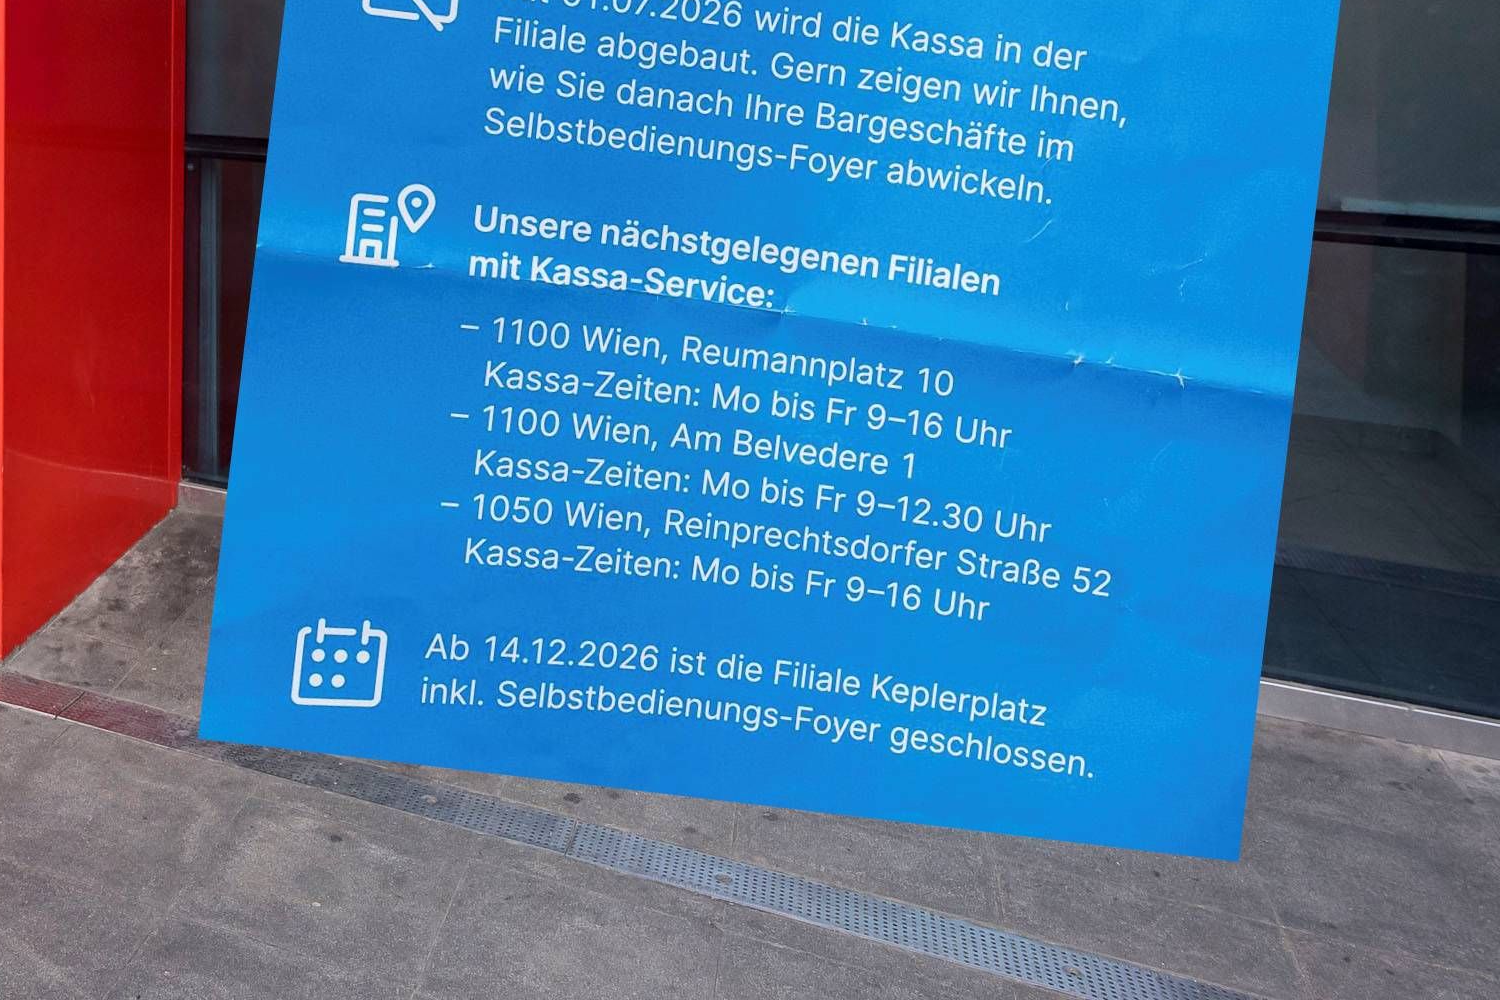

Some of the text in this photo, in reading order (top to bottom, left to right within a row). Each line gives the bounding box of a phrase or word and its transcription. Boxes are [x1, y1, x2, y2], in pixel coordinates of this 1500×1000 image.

[493, 14, 1127, 130] Filiale abgebaut. Gern zeigen wir Ihnen,
[753, 8, 823, 40] wird
[831, 14, 881, 47] die
[889, 20, 985, 60] Kassa
[994, 32, 1023, 65] in
[1031, 39, 1089, 72] der
[483, 106, 1053, 206] Selbstbedienungs-Foyer abwickeln.
[488, 63, 1075, 163] wie Sie danach Ihre Bargeschäfte im
[467, 250, 775, 310] mit Kassa-Service:
[473, 203, 1001, 297] Unsere nächstgelegenen Filialen
[492, 315, 571, 350] 1100
[581, 324, 669, 366] Wien,
[680, 334, 905, 391] Reumannplatz
[917, 366, 955, 398] 10
[482, 404, 561, 438] 1100
[571, 411, 659, 453] Wien,
[669, 421, 723, 454] Am
[732, 427, 890, 476] Belvedere
[902, 451, 916, 480] 1
[483, 359, 702, 408] Kassa-Zeiten:
[711, 381, 762, 415] Mo
[770, 389, 816, 422] bis
[825, 396, 859, 427] Fr
[954, 414, 1014, 450] Uhr
[473, 447, 691, 494] Kassa-Zeiten:
[700, 468, 751, 501] Mo
[759, 475, 806, 509] bis
[814, 483, 848, 514] Fr
[993, 508, 1054, 544] Uhr
[463, 536, 681, 581] Kassa-Zeiten:
[690, 554, 741, 586] Mo
[749, 561, 796, 594] bis
[804, 568, 838, 599] Fr
[932, 587, 992, 622] Uhr
[472, 492, 554, 526] 1050
[564, 499, 651, 540] Wien,
[663, 507, 949, 571] Reinprechtsdorfer
[955, 547, 1062, 590] Straße
[1071, 565, 1113, 598] 52
[423, 631, 1048, 728] Ab 14.12.2026 ist die Filiale Keplerplatz
[420, 675, 1095, 780] inkl. Selbstbedienungs-Foyer geschlossen.
